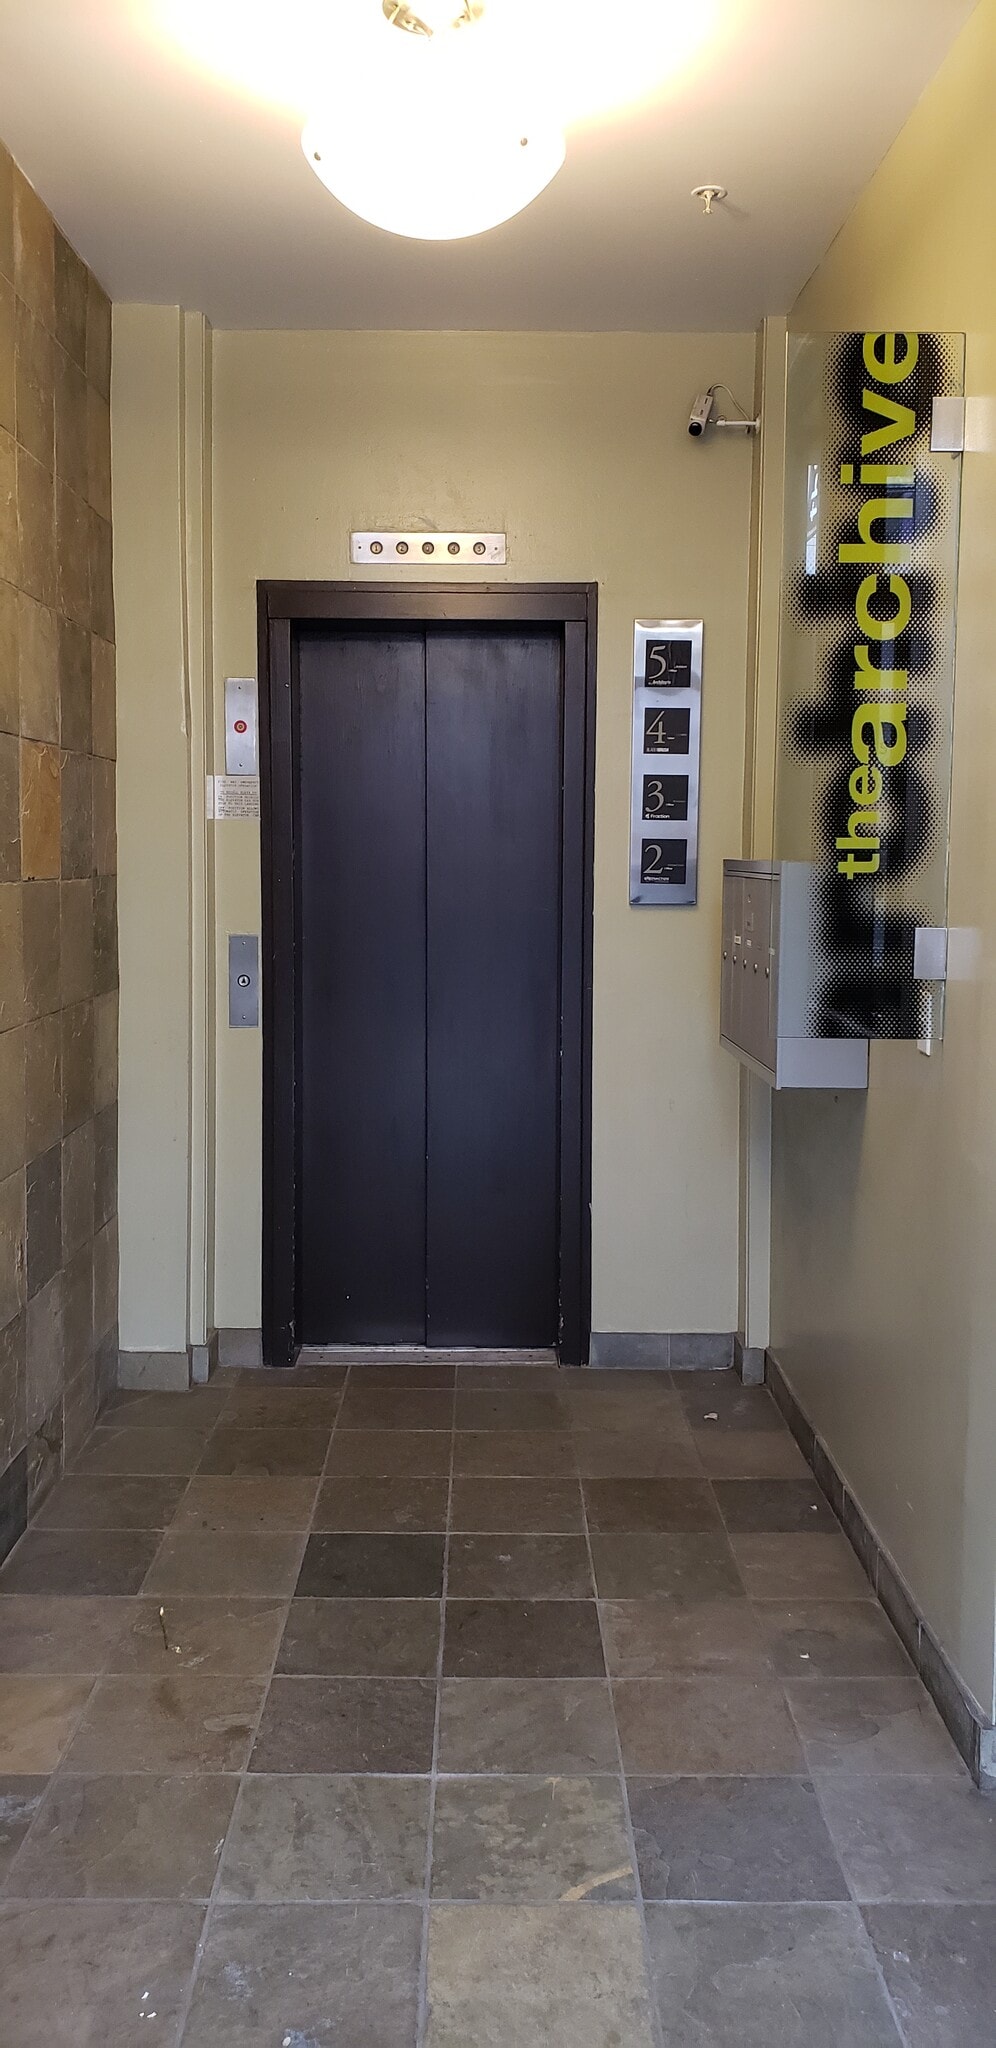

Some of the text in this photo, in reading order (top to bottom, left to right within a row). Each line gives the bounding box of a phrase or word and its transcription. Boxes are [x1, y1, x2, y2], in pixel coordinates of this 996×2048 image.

[648, 645, 667, 679] 5
[646, 710, 667, 744] 4
[645, 780, 665, 813] 3
[643, 844, 664, 874] 2
